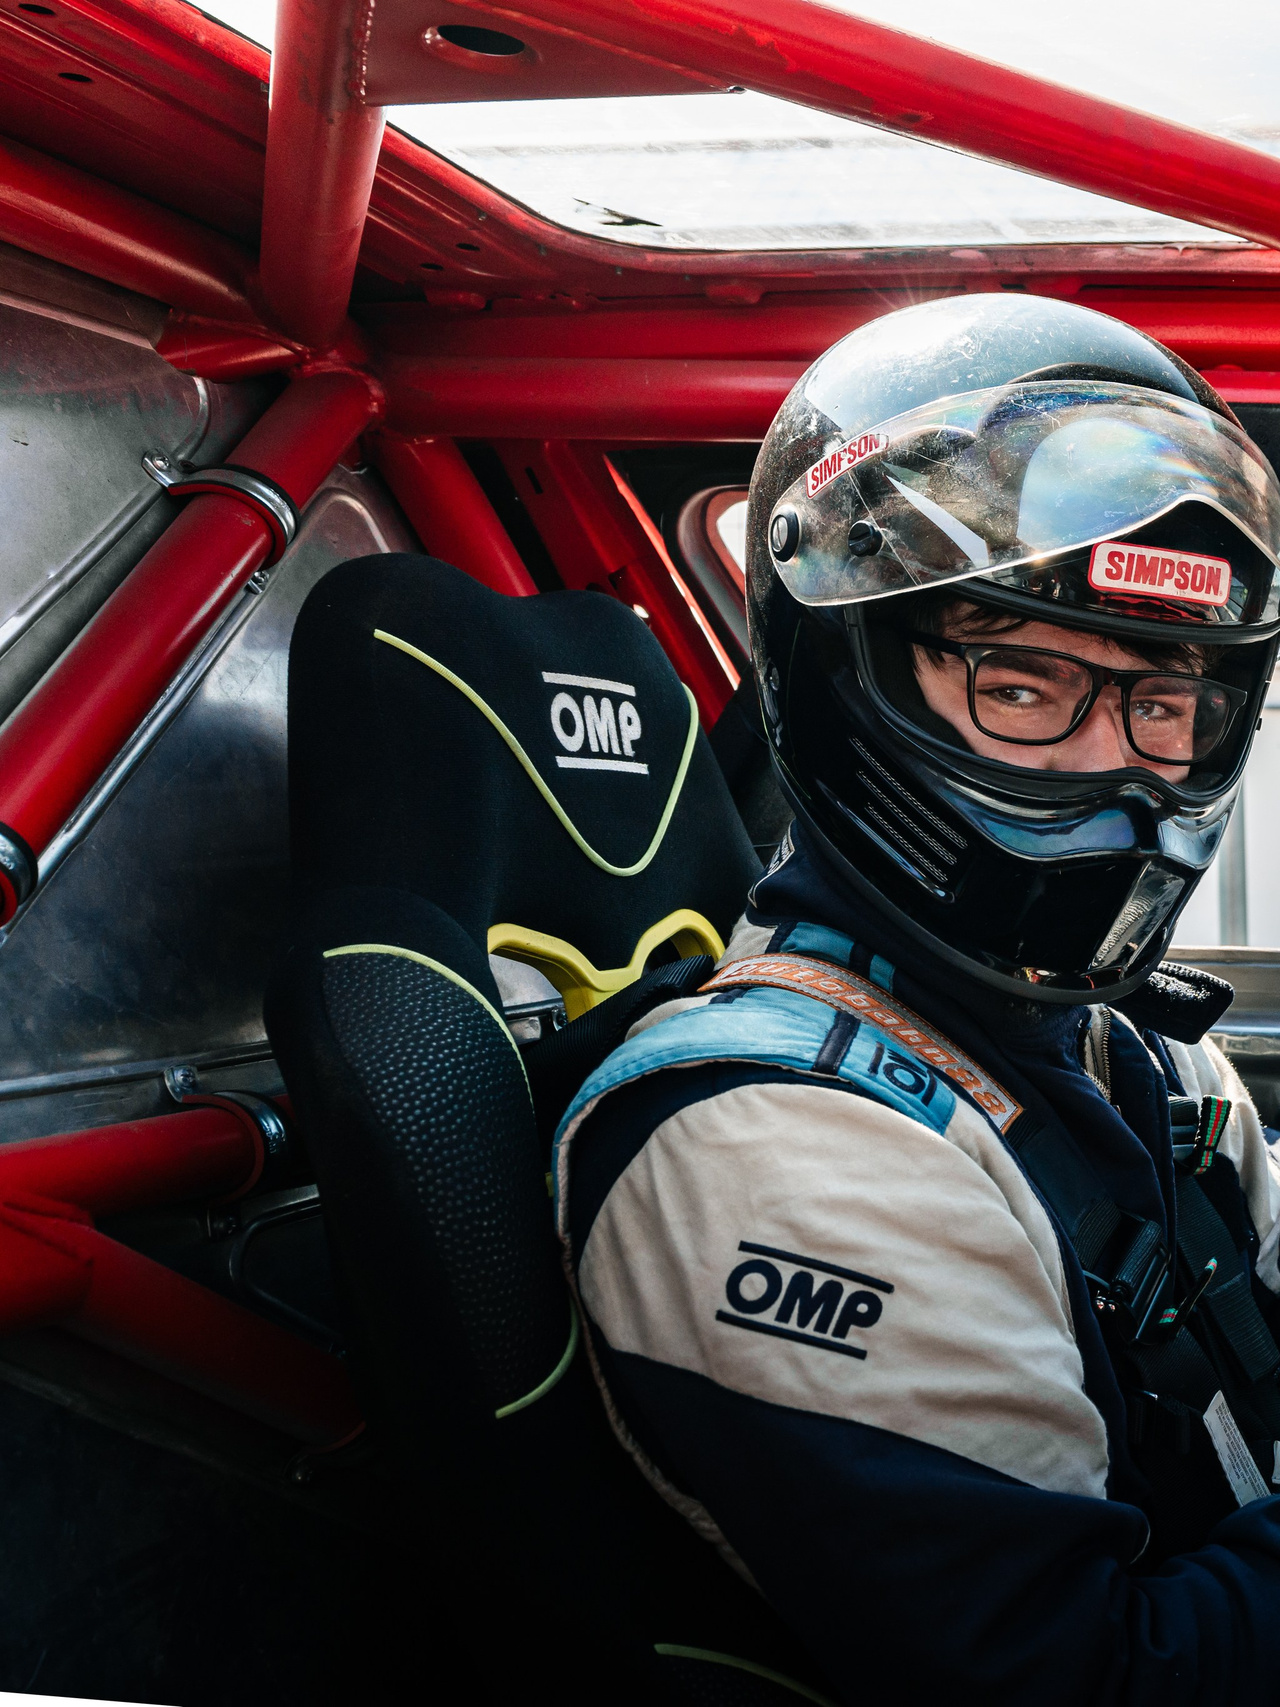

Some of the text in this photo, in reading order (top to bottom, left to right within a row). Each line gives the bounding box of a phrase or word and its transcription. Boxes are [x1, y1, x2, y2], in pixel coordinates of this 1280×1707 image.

[811, 434, 880, 491] SIMPSON
[1105, 550, 1222, 596] SIMPSON
[550, 692, 642, 757] OMP
[720, 962, 1008, 1116] autobahn88
[726, 1258, 883, 1340] OMP
